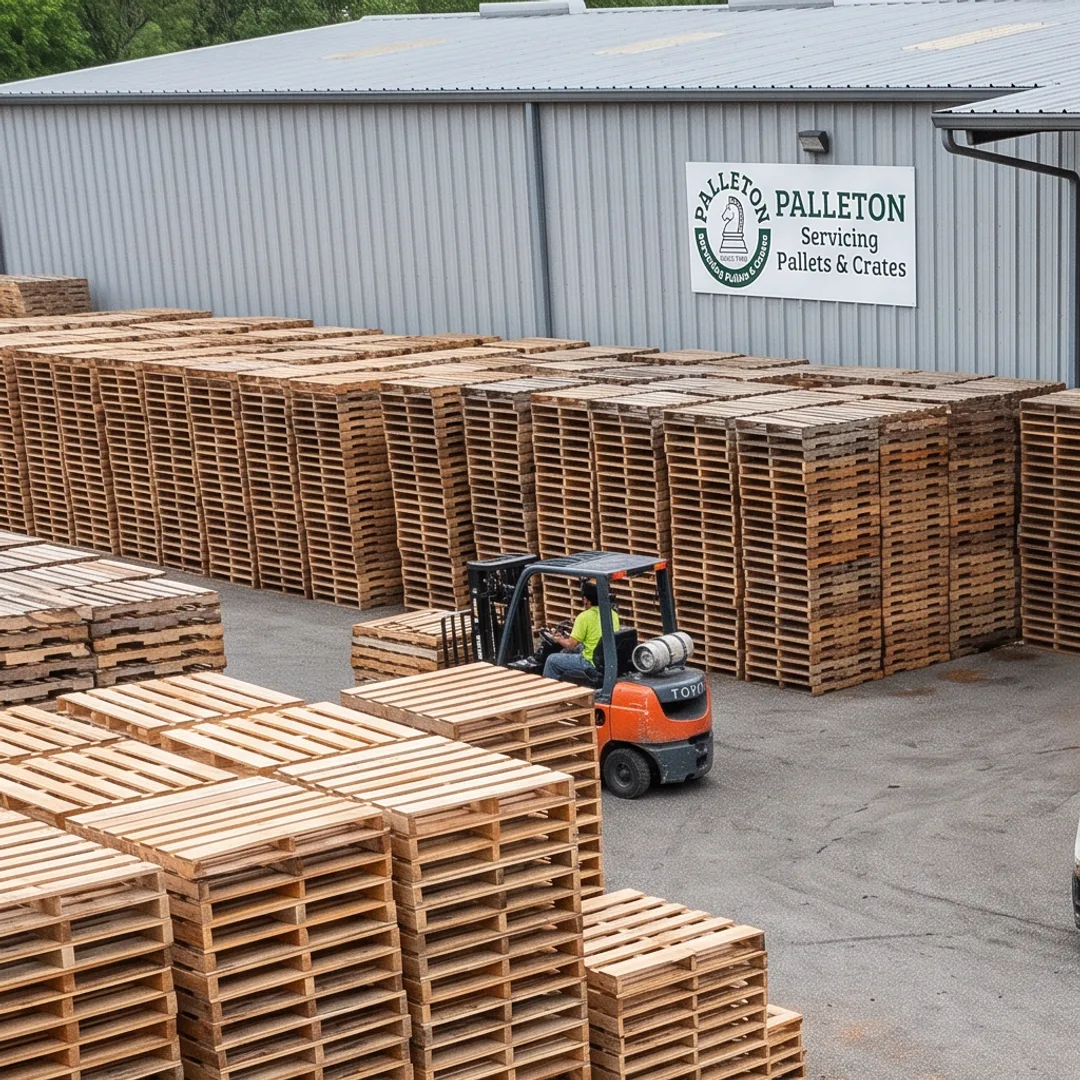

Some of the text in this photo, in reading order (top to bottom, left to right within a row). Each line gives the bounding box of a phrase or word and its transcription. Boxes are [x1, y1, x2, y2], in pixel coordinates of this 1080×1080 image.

[694, 170, 771, 224] PALLETON
[775, 190, 906, 222] PALLETON
[801, 226, 878, 253] Servicing
[777, 251, 831, 273] Pallets
[836, 254, 848, 274] &
[852, 255, 907, 277] Crates
